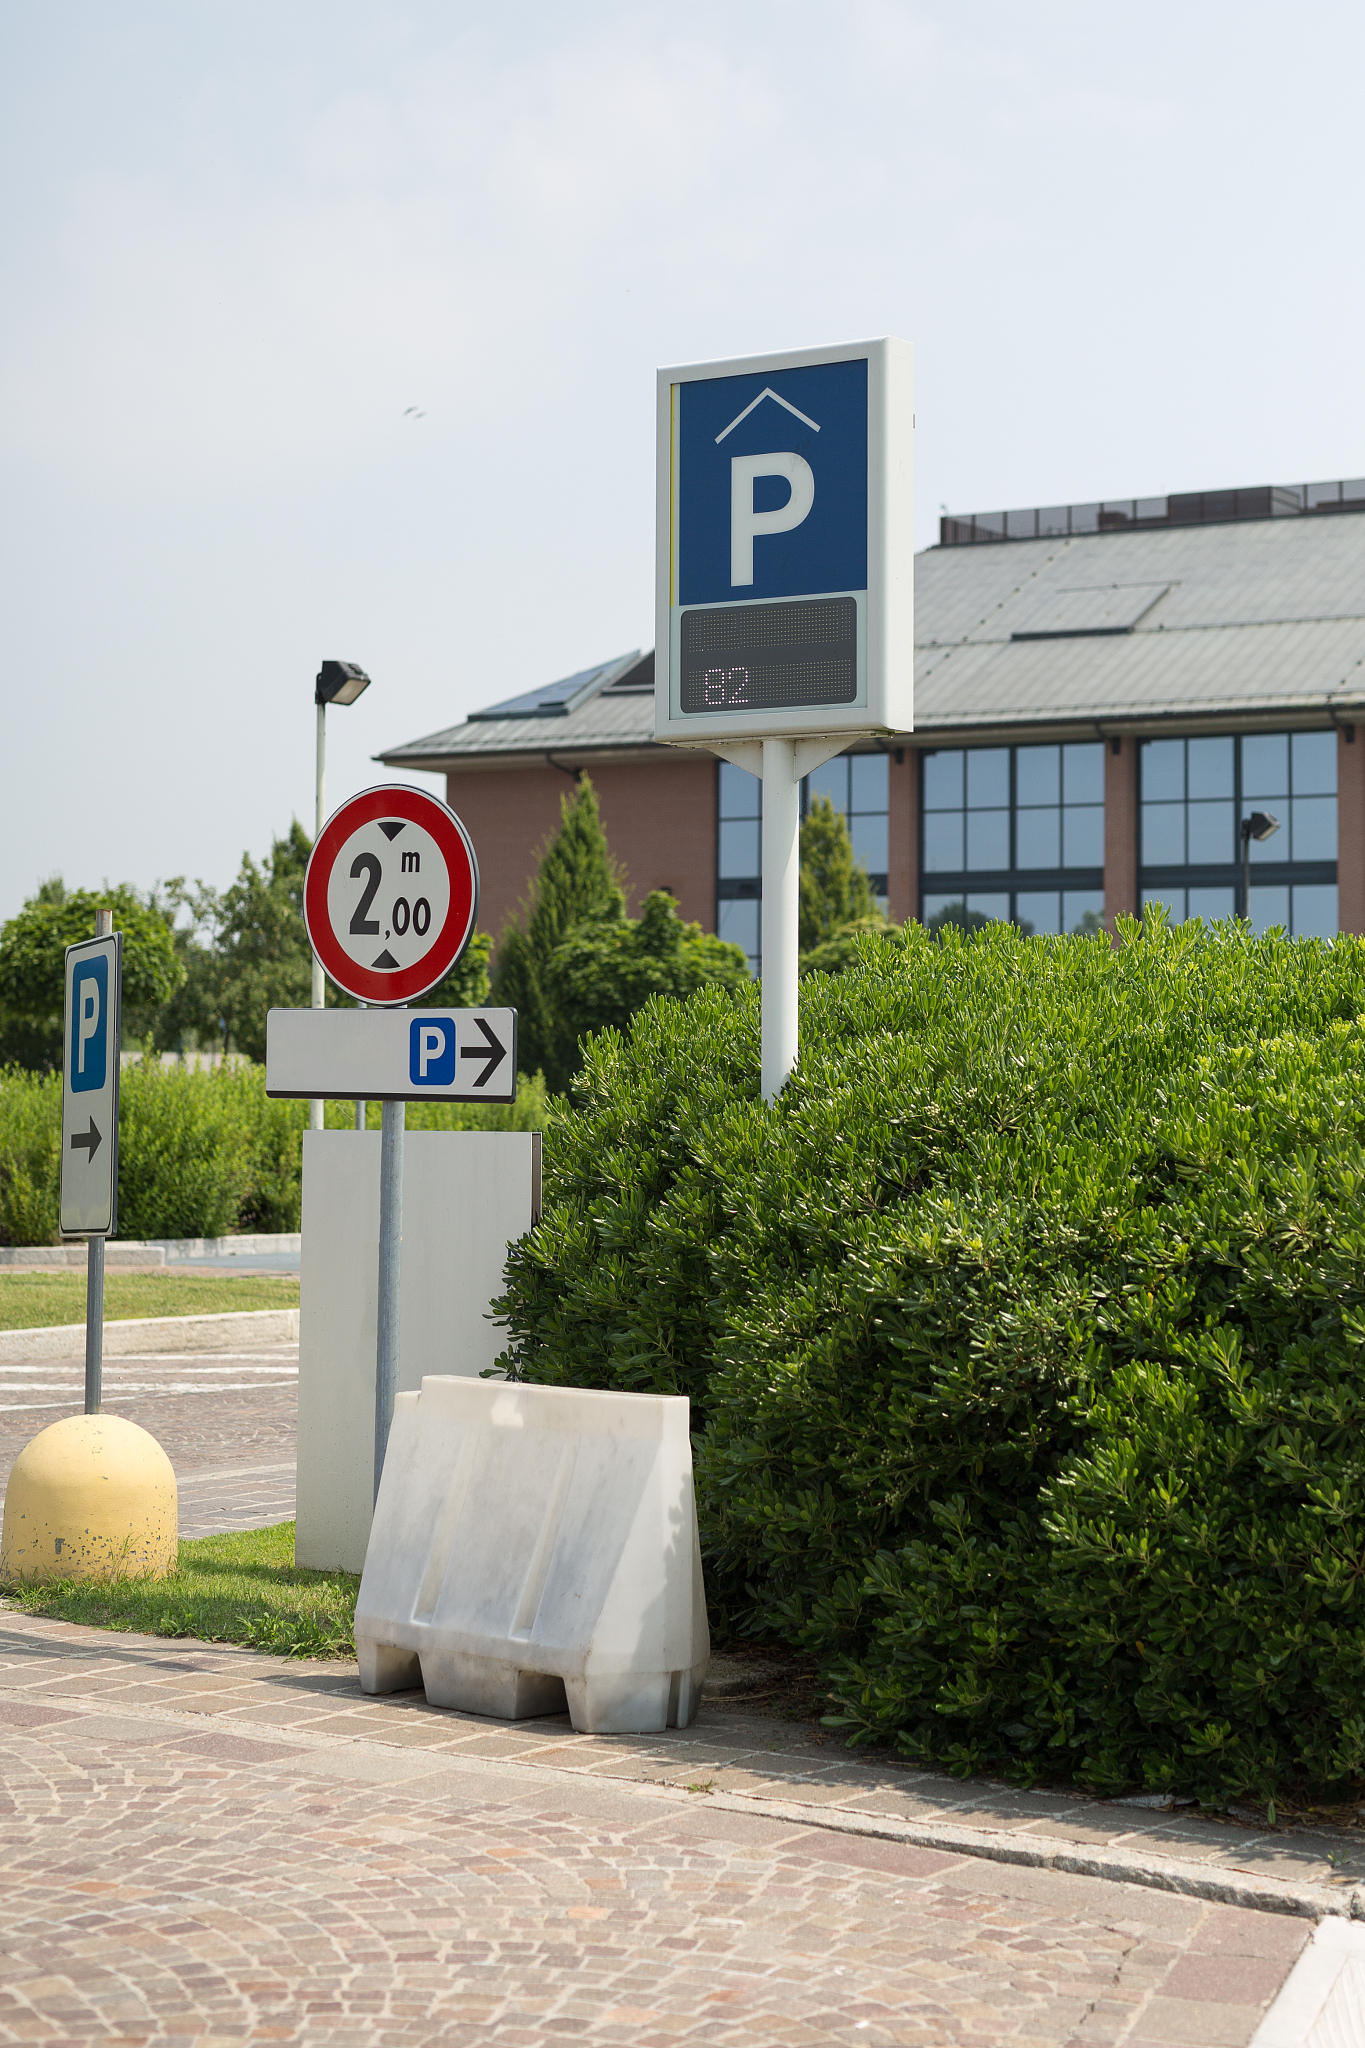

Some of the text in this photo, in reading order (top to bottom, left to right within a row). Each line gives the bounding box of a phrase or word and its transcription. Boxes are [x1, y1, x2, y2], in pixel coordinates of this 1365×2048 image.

[730, 451, 815, 587] P
[704, 667, 749, 705] 82
[401, 852, 420, 872] m
[79, 978, 99, 1073] P
[419, 1026, 446, 1077] P
